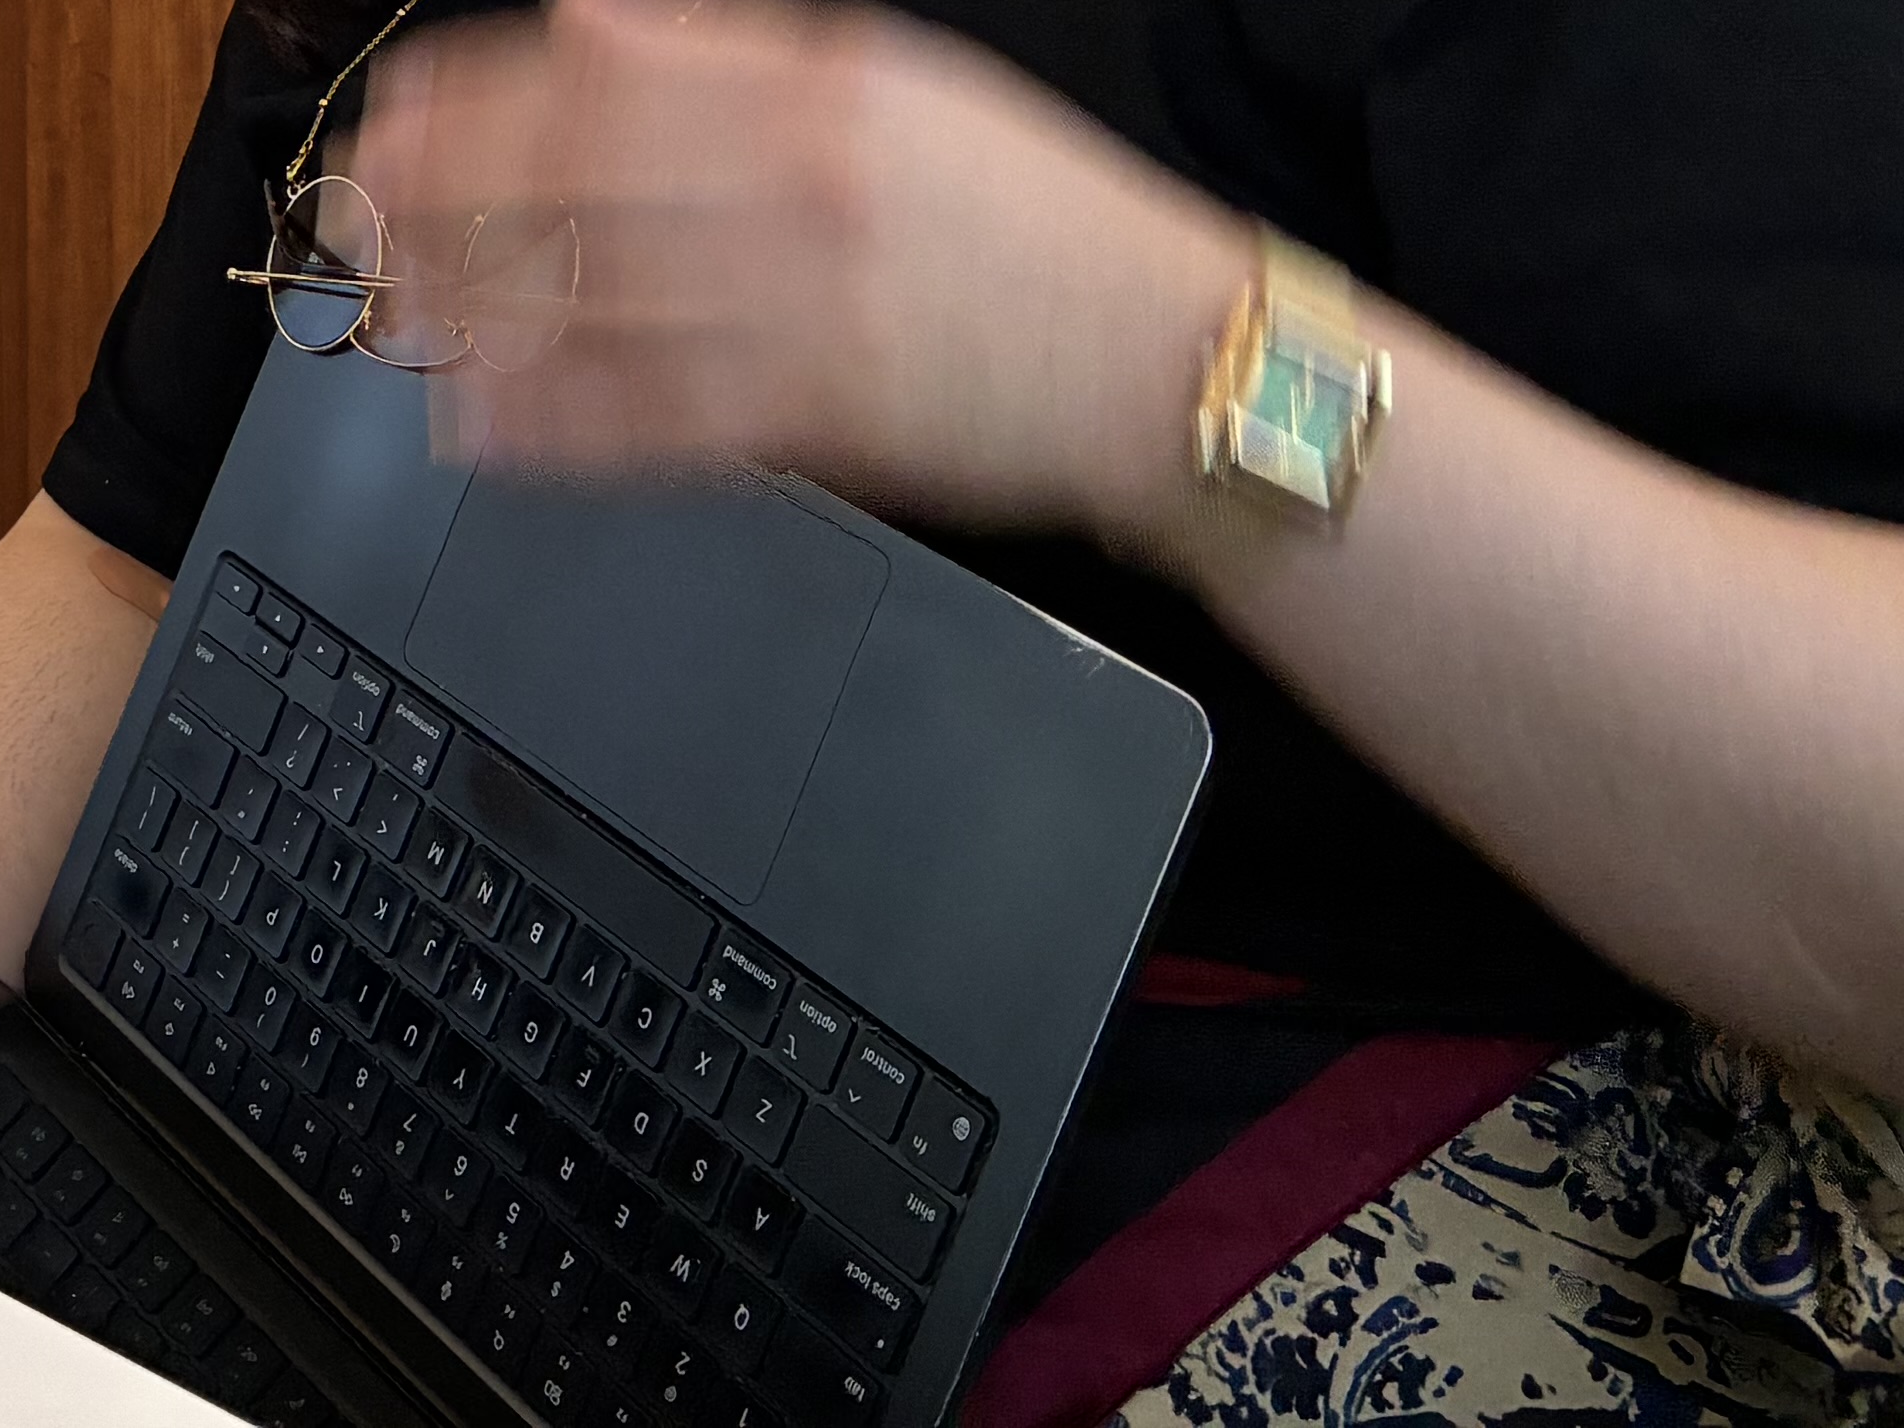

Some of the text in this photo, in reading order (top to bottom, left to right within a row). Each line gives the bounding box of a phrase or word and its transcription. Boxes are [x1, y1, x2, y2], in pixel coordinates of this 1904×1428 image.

[428, 842, 444, 864] M
[333, 861, 341, 880] L
[477, 881, 493, 903] N
[267, 909, 279, 925] P
[374, 898, 388, 920] K
[530, 923, 544, 943] B
[424, 940, 436, 956] J
[582, 966, 595, 986] V
[722, 944, 777, 992] command
[472, 977, 487, 1000] H
[638, 1008, 652, 1028] C
[798, 1000, 837, 1034] option
[310, 1027, 321, 1046] 9
[404, 1025, 417, 1046] U
[524, 1022, 538, 1042] G
[695, 1052, 712, 1075] X
[862, 1046, 906, 1086] control
[356, 1068, 368, 1088] 8
[453, 1069, 465, 1089] Y
[577, 1069, 591, 1087] F
[756, 1099, 772, 1122] Z
[403, 1114, 416, 1132] 7
[505, 1114, 518, 1134] T
[634, 1112, 649, 1134] D
[912, 1136, 928, 1156] fn
[454, 1156, 467, 1176] 6
[561, 1157, 574, 1180] R
[692, 1159, 707, 1181] S
[507, 1202, 520, 1223] 5
[615, 1205, 629, 1228] E
[906, 1193, 936, 1222] shift
[755, 1208, 769, 1230] A
[560, 1251, 574, 1269] 4
[670, 1255, 690, 1282] W
[844, 1260, 900, 1311] caps lock
[617, 1301, 631, 1323] 3
[734, 1304, 749, 1330] Q
[675, 1352, 690, 1375] 2
[844, 1376, 865, 1402] tab
